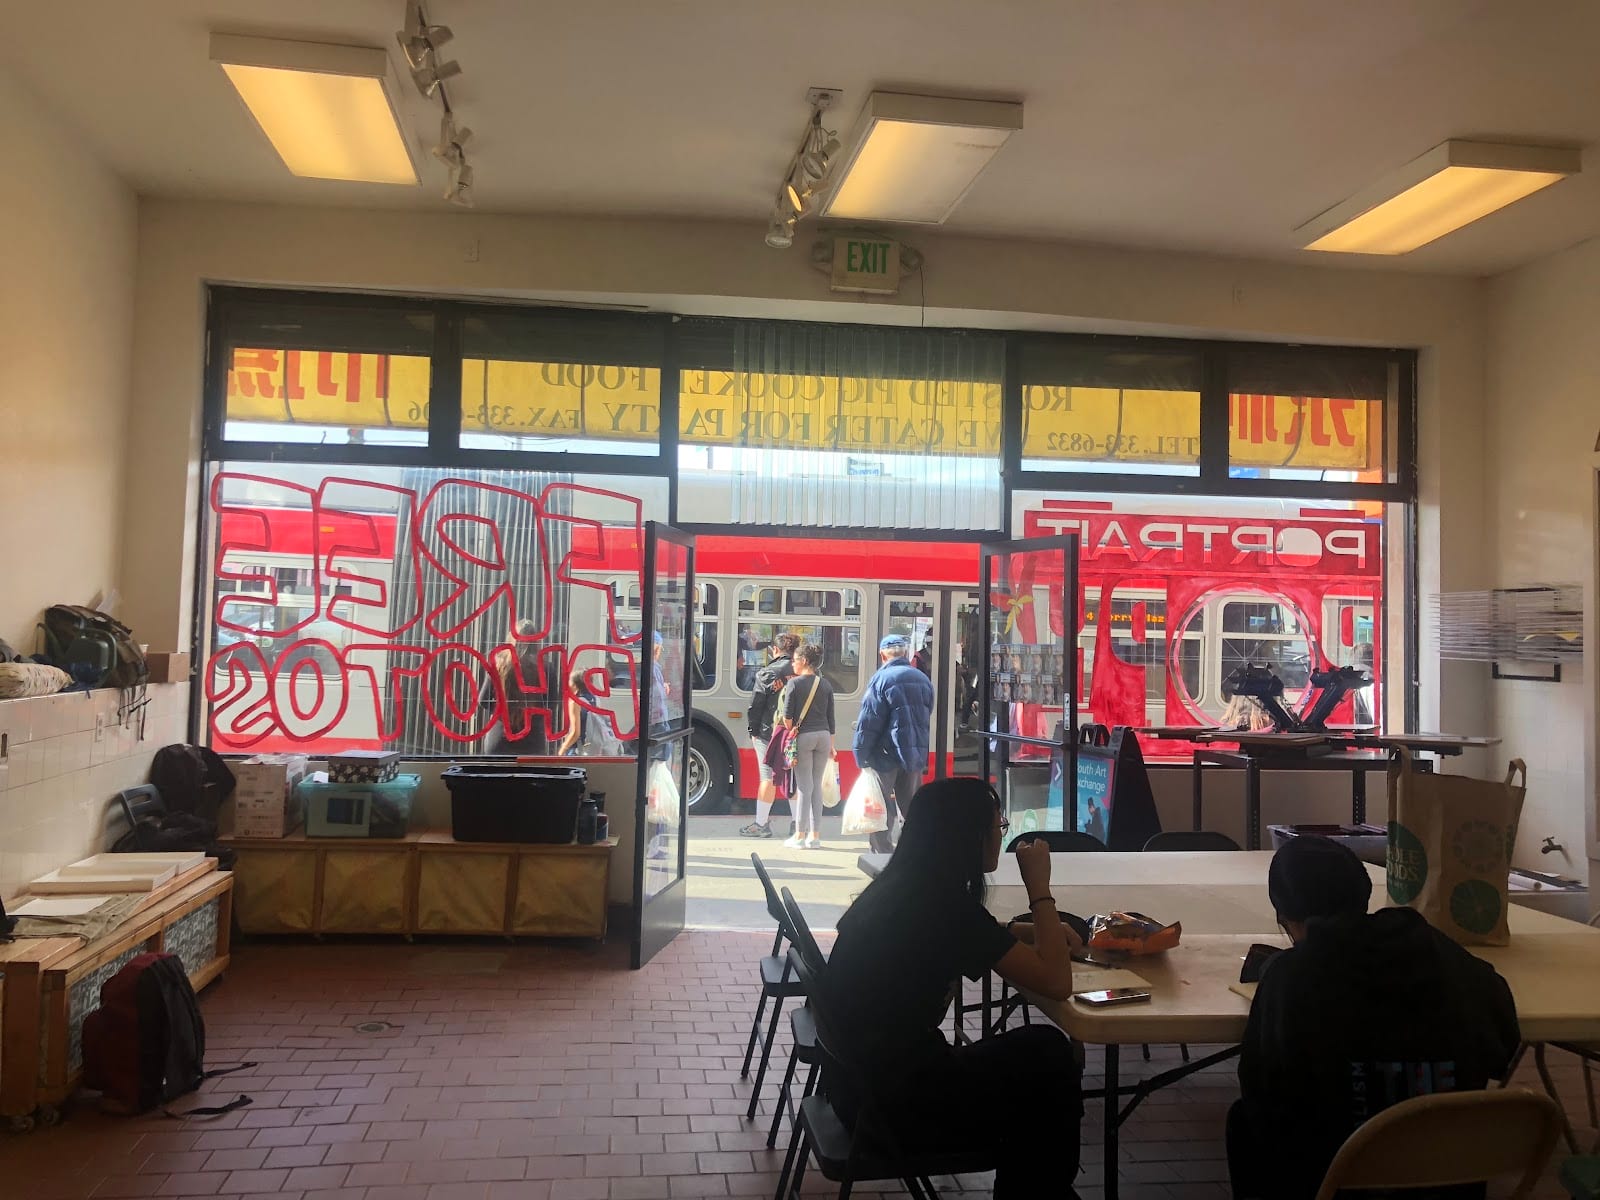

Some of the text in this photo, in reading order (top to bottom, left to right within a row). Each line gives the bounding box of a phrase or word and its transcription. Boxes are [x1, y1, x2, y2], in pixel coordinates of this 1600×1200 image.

[847, 241, 890, 274] EXIT
[1078, 763, 1107, 778] outh Art
